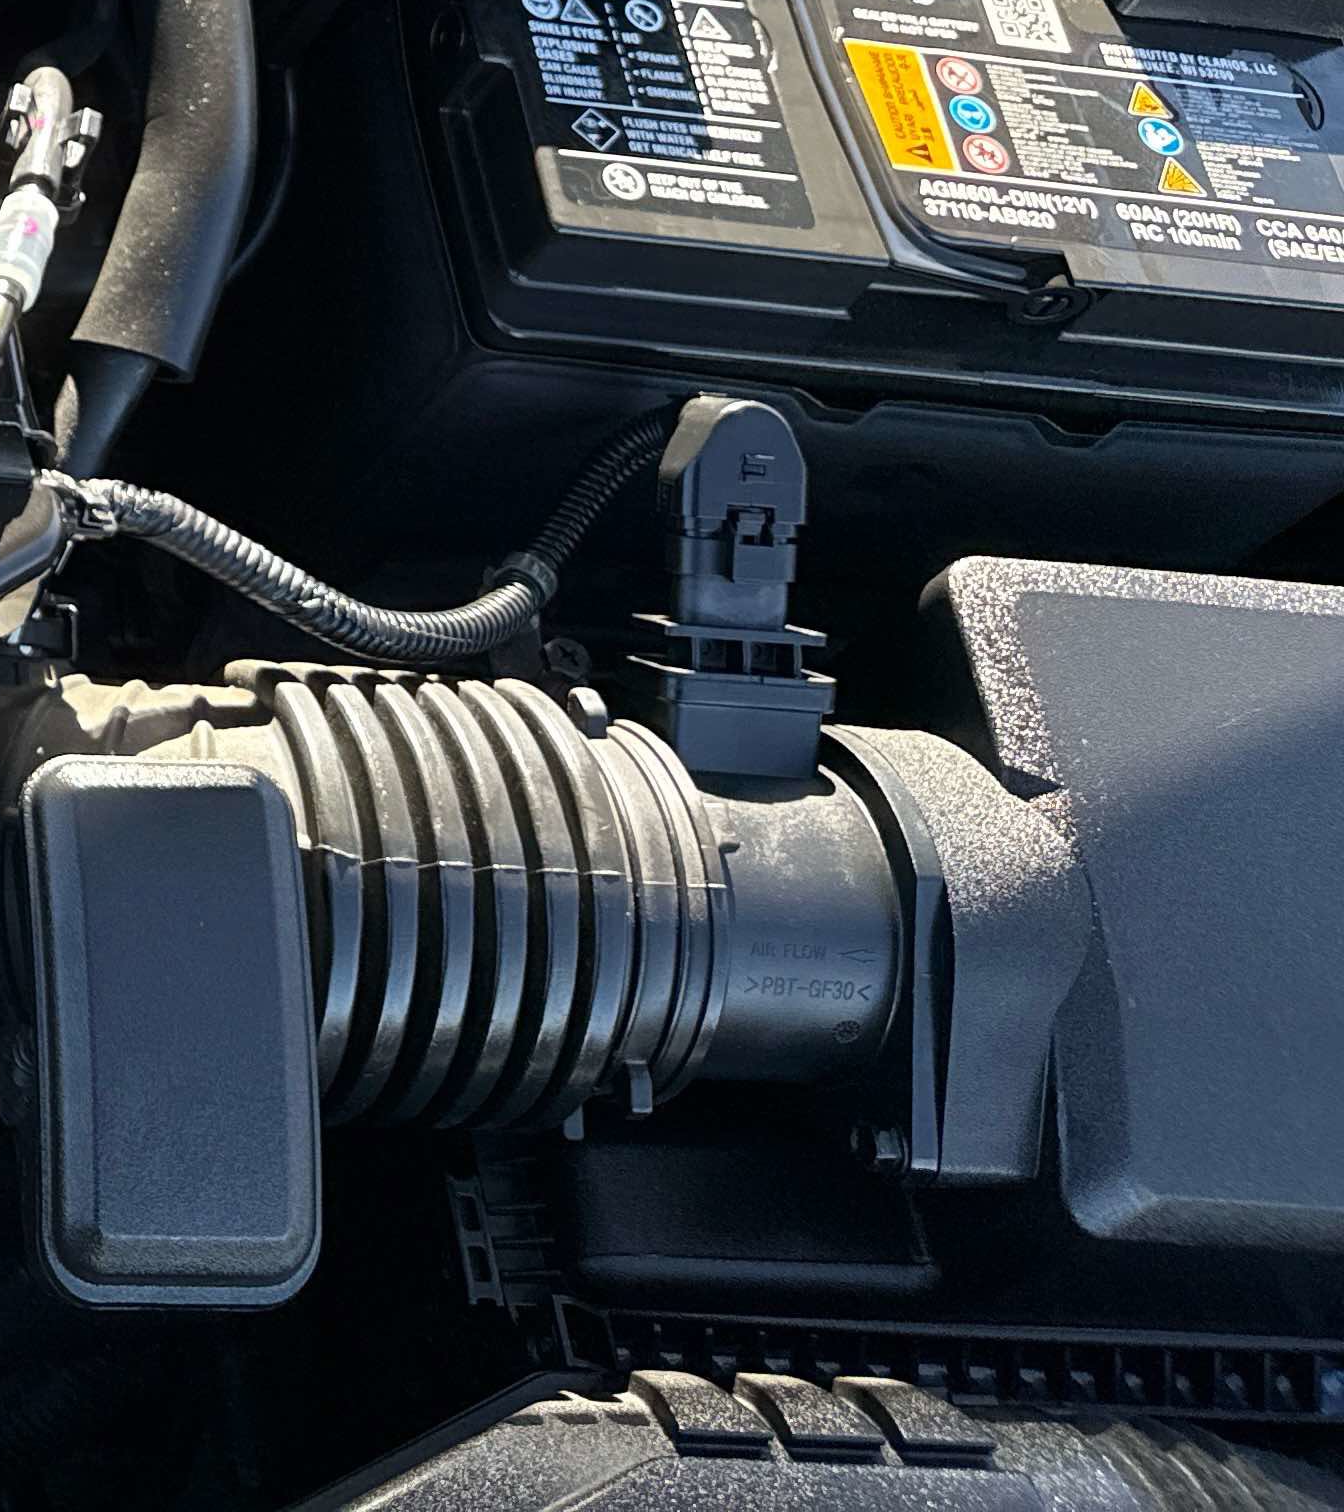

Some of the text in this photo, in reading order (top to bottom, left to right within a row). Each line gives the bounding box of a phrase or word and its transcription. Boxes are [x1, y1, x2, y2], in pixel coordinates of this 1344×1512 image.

[527, 19, 571, 37] SHIELD
[532, 35, 600, 55] EXPLOSIVE
[536, 47, 576, 63] GASES
[636, 50, 681, 66] SPARKS
[538, 60, 602, 78] CAN CAUSE
[1179, 53, 1195, 66] BY
[1254, 62, 1279, 76] LLC
[1180, 64, 1198, 77] WI
[541, 72, 604, 90] BLINDNESS
[642, 69, 685, 84] FLAMES
[545, 84, 562, 97] OR
[645, 85, 697, 102] SMOKING
[622, 116, 658, 130] FLUSH
[659, 119, 688, 135] EYES
[624, 129, 655, 142] WITH
[628, 140, 651, 153] GET
[652, 143, 703, 160] MEDICAL
[918, 178, 1100, 220] AGM60L-DIN(12V)
[923, 197, 1057, 230] 37110-AB620
[1115, 202, 1243, 237] 60Ah (20HR)
[1129, 221, 1243, 252] RC 100min
[1255, 218, 1344, 246] CCA 640
[750, 941, 829, 961] AIR FLOW
